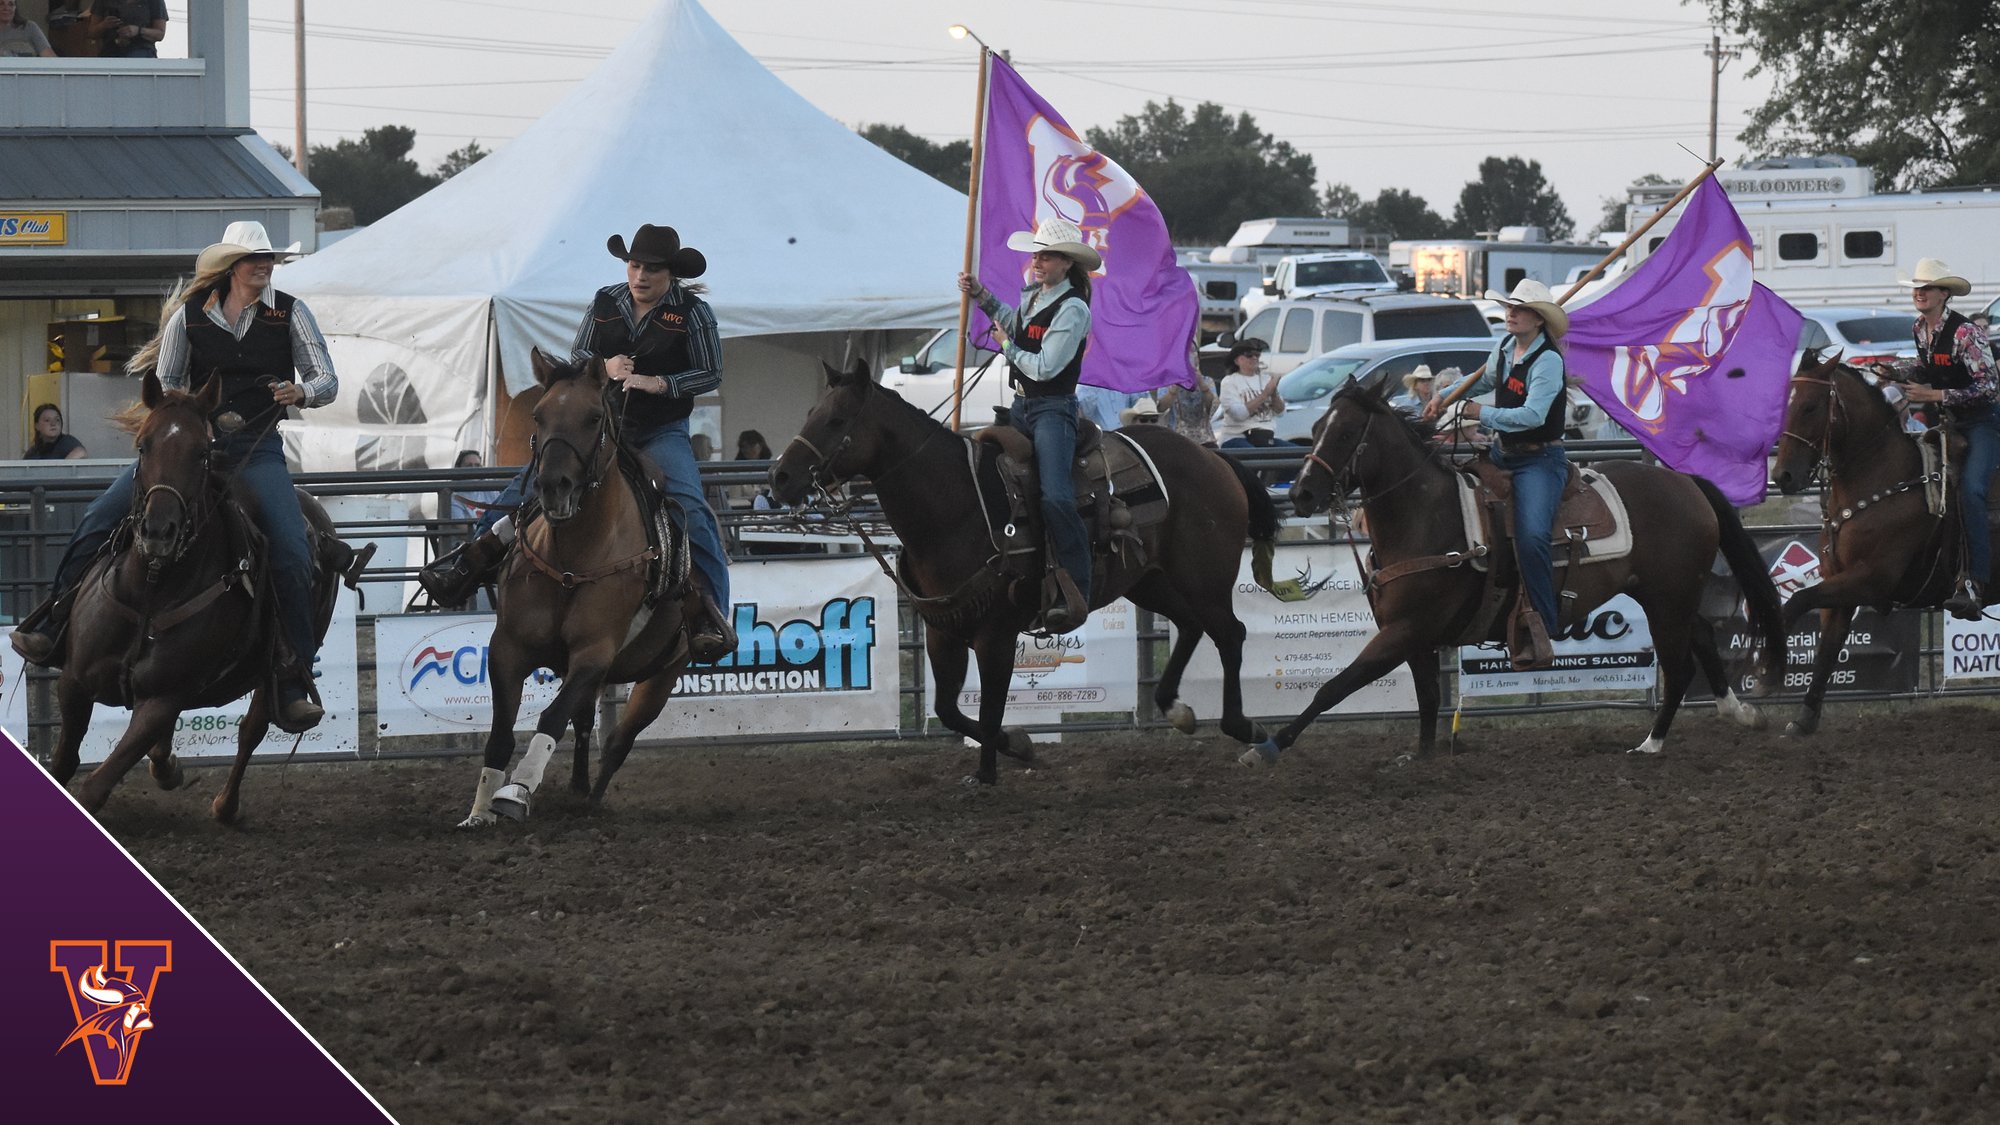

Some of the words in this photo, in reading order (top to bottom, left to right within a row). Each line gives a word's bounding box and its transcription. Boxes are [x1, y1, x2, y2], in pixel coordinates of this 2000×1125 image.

[1737, 179, 1829, 194] BLOOMER
[20, 219, 50, 233] Club
[263, 309, 287, 318] MVC
[661, 311, 683, 325] MVC
[1274, 612, 1318, 625] MARTIN
[1321, 611, 1375, 623] HEMENW
[1274, 630, 1307, 640] Account
[1309, 629, 1368, 639] Representative
[730, 596, 876, 690] hoff
[1284, 652, 1333, 662] 479-685-4035
[1592, 655, 1638, 665] SALON
[671, 669, 820, 695] ONSTRUCTION
[1470, 681, 1484, 690] 115
[1496, 679, 1520, 688] Arrow
[1568, 676, 1581, 685] Mo
[1592, 674, 1647, 684] 660.631.2414
[1037, 690, 1098, 701] 660-886-7289
[201, 732, 239, 746] Non-G
[265, 731, 324, 744] Resource
